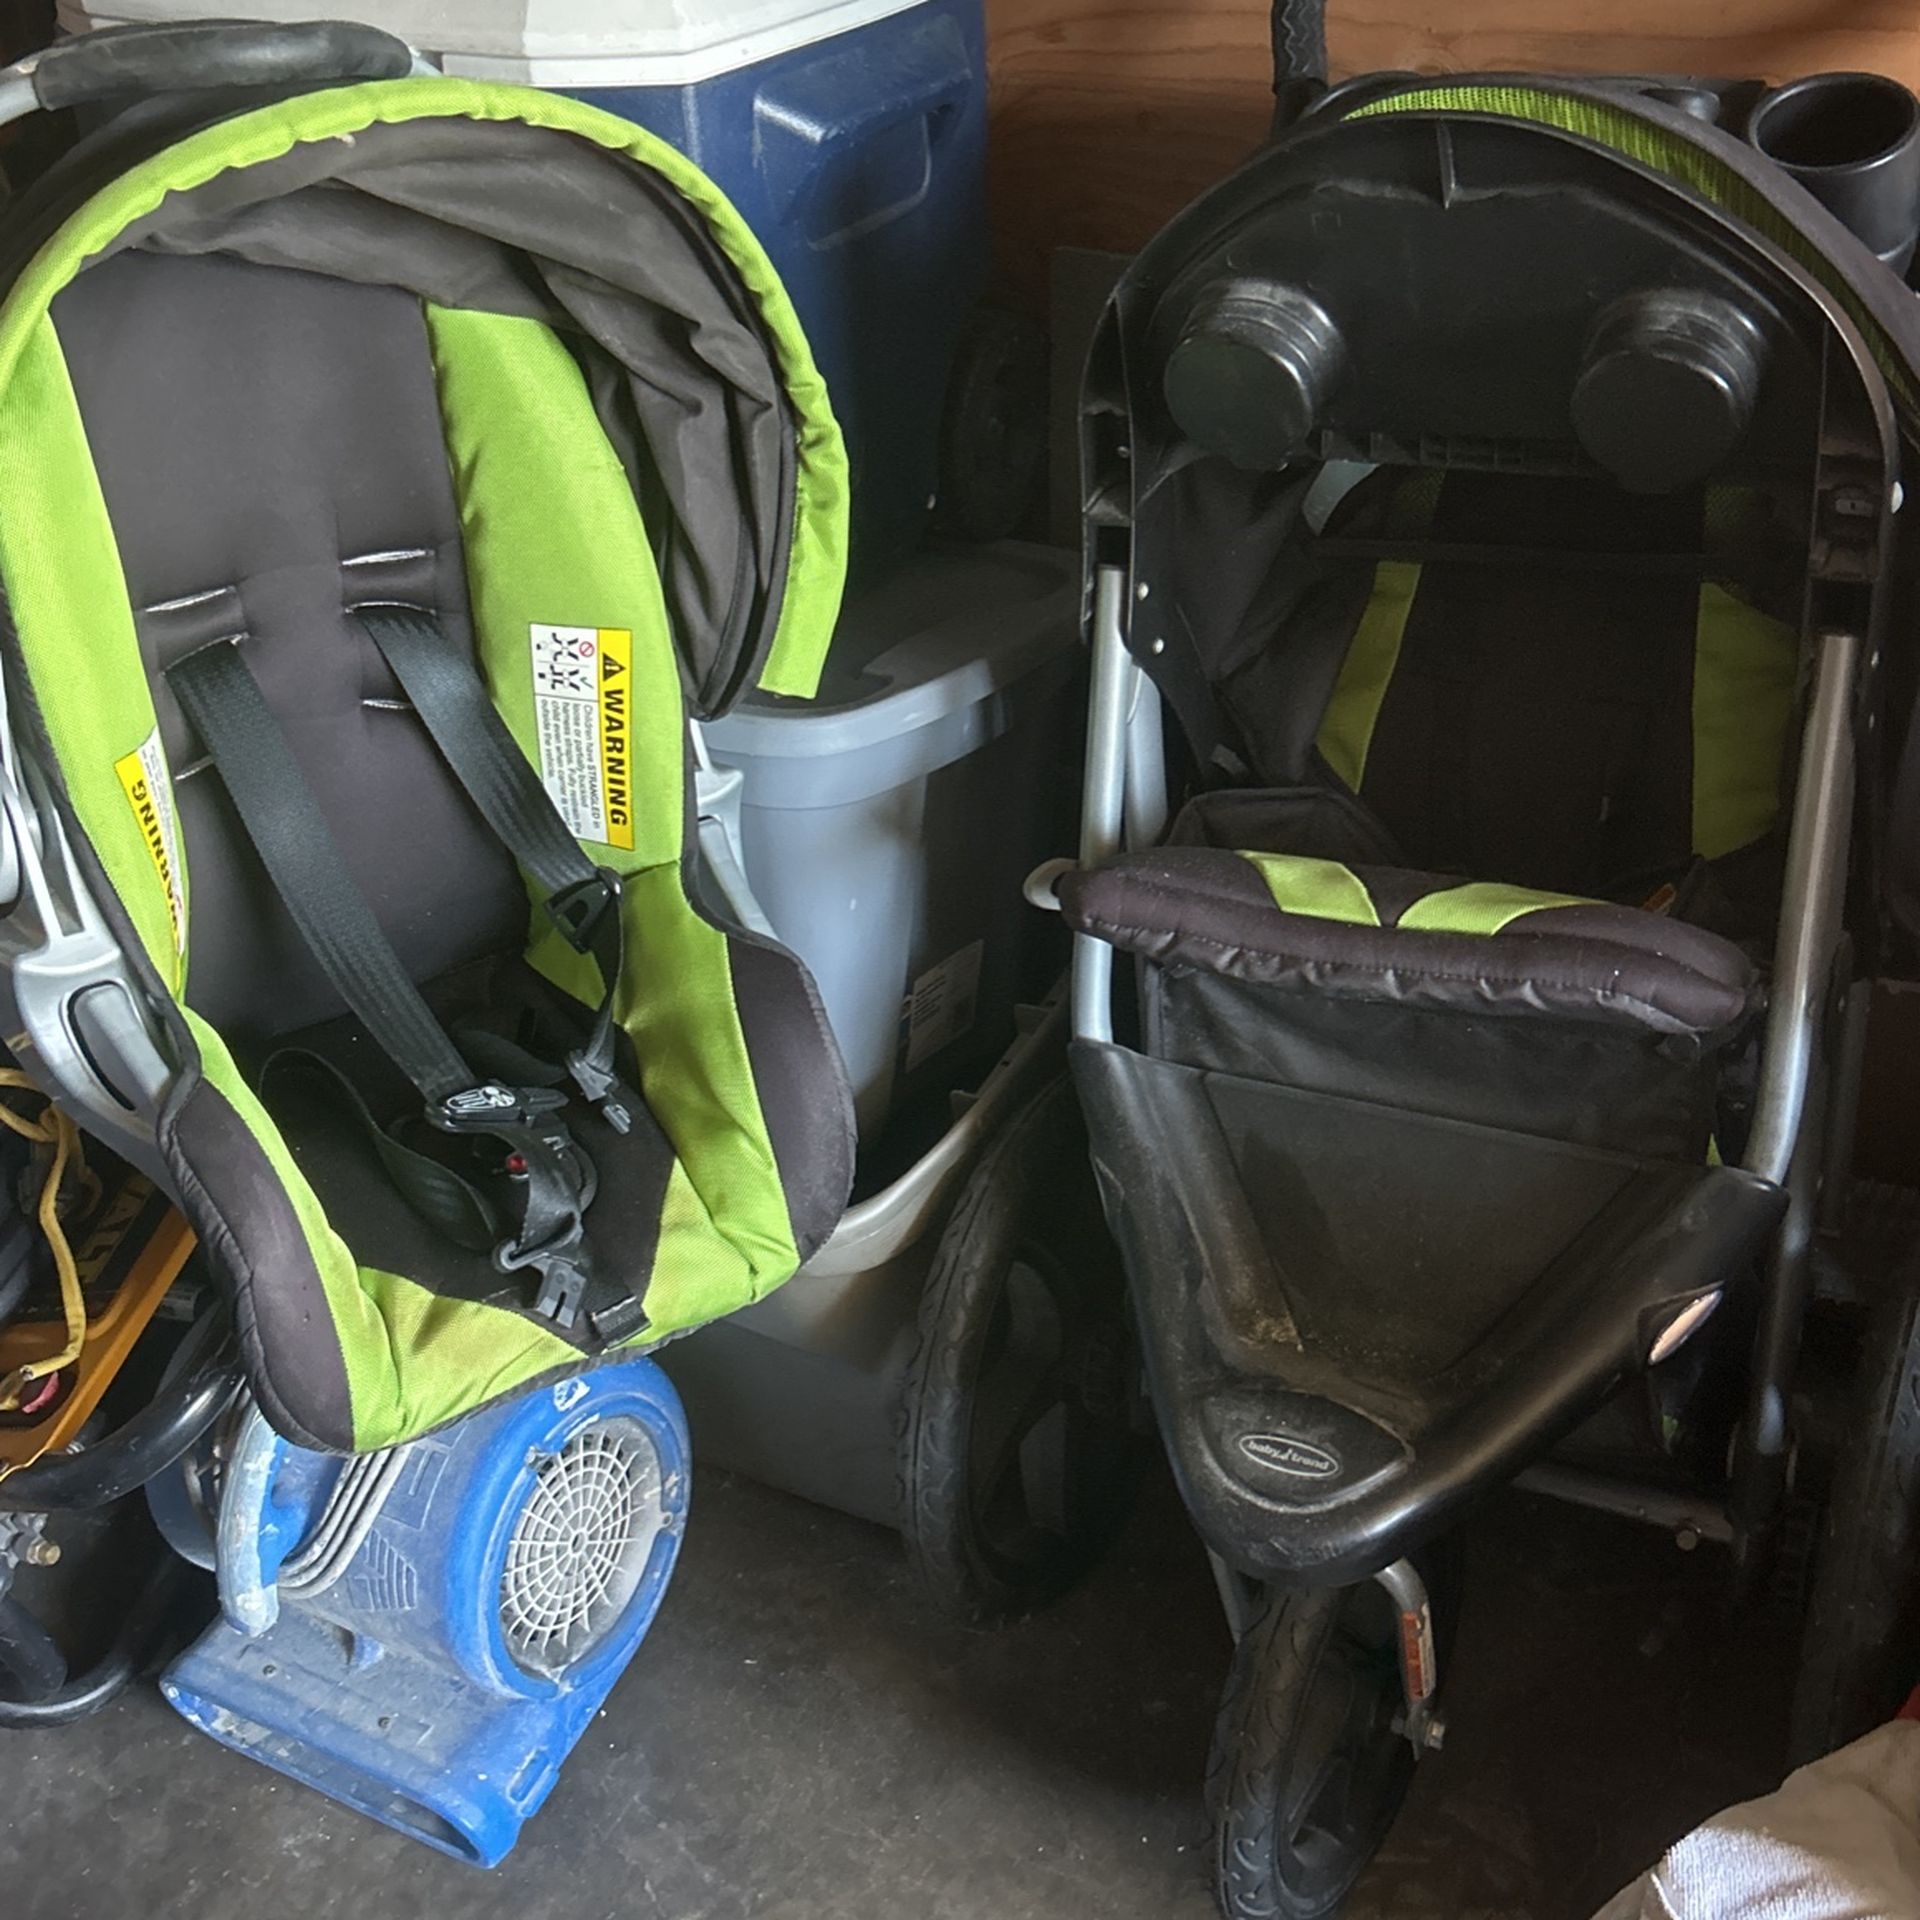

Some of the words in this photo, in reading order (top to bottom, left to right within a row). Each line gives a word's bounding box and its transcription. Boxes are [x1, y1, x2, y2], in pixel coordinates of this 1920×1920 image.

[542, 699, 552, 731] outside
[552, 700, 563, 721] child
[562, 702, 573, 736] harness
[573, 703, 581, 727] loose
[584, 705, 594, 740] Children
[554, 723, 564, 744] even
[556, 746, 566, 768] when
[574, 739, 586, 773] partially
[586, 742, 596, 763] have
[604, 689, 627, 826] WARNING
[558, 770, 568, 796] carrier
[567, 768, 578, 788] Fully
[578, 775, 590, 808] buckled
[587, 765, 600, 820] STRANGLED
[570, 789, 581, 820] restrain
[1248, 1440, 1281, 1457] baby
[1291, 1452, 1330, 1470] trend
